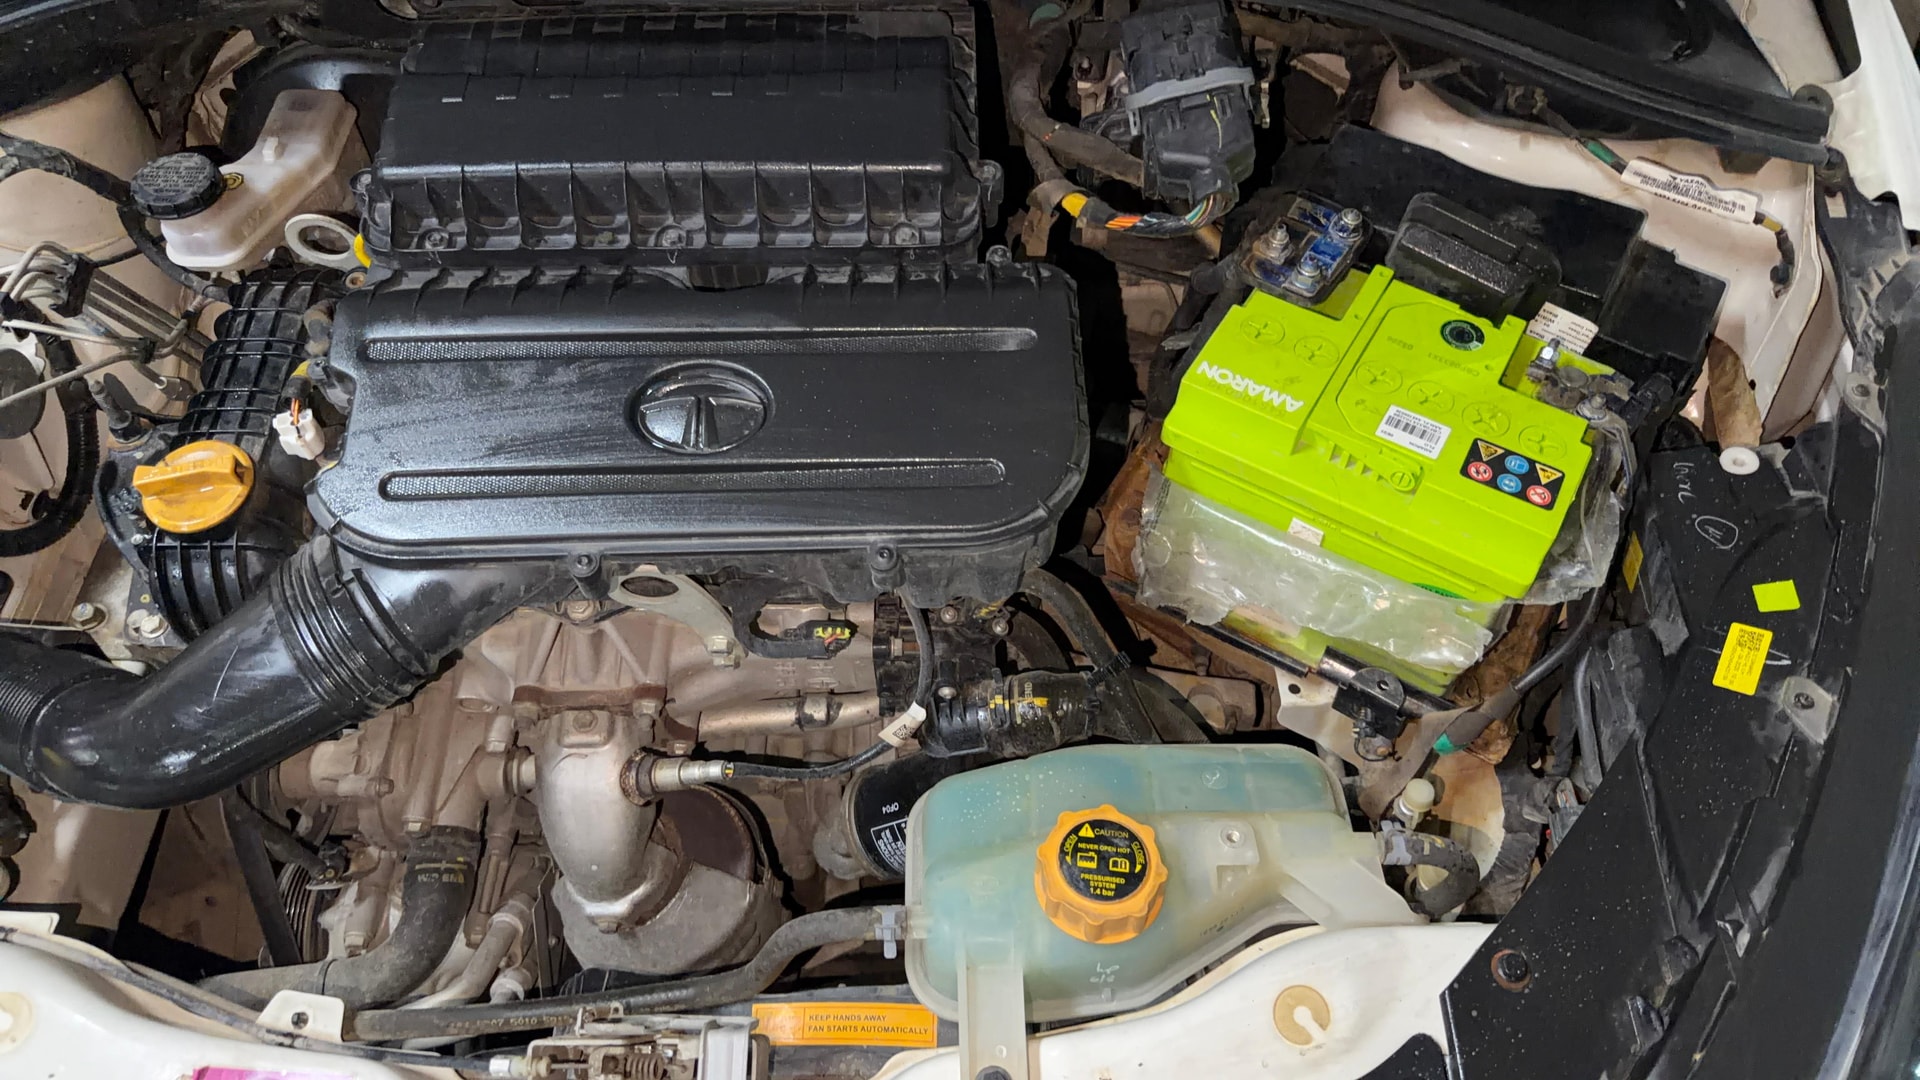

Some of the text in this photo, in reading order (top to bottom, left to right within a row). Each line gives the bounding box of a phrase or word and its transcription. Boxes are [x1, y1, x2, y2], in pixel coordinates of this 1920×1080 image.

[1196, 360, 1304, 413] AMARON
[882, 802, 900, 814] OF04
[1094, 828, 1129, 838] CAUTION
[1064, 833, 1078, 852] OPEN
[1078, 842, 1131, 854] NEVER OPEN HOT
[1131, 841, 1146, 866] CLOSE
[1080, 873, 1126, 884] PRESSURISED
[1090, 881, 1116, 890] SYSTEM
[1090, 887, 1116, 897] 1.4 bar
[809, 1014, 887, 1022] KEEP HANDS AWAY
[808, 1024, 928, 1035] FAN STARTS AUTOMATICALLY
